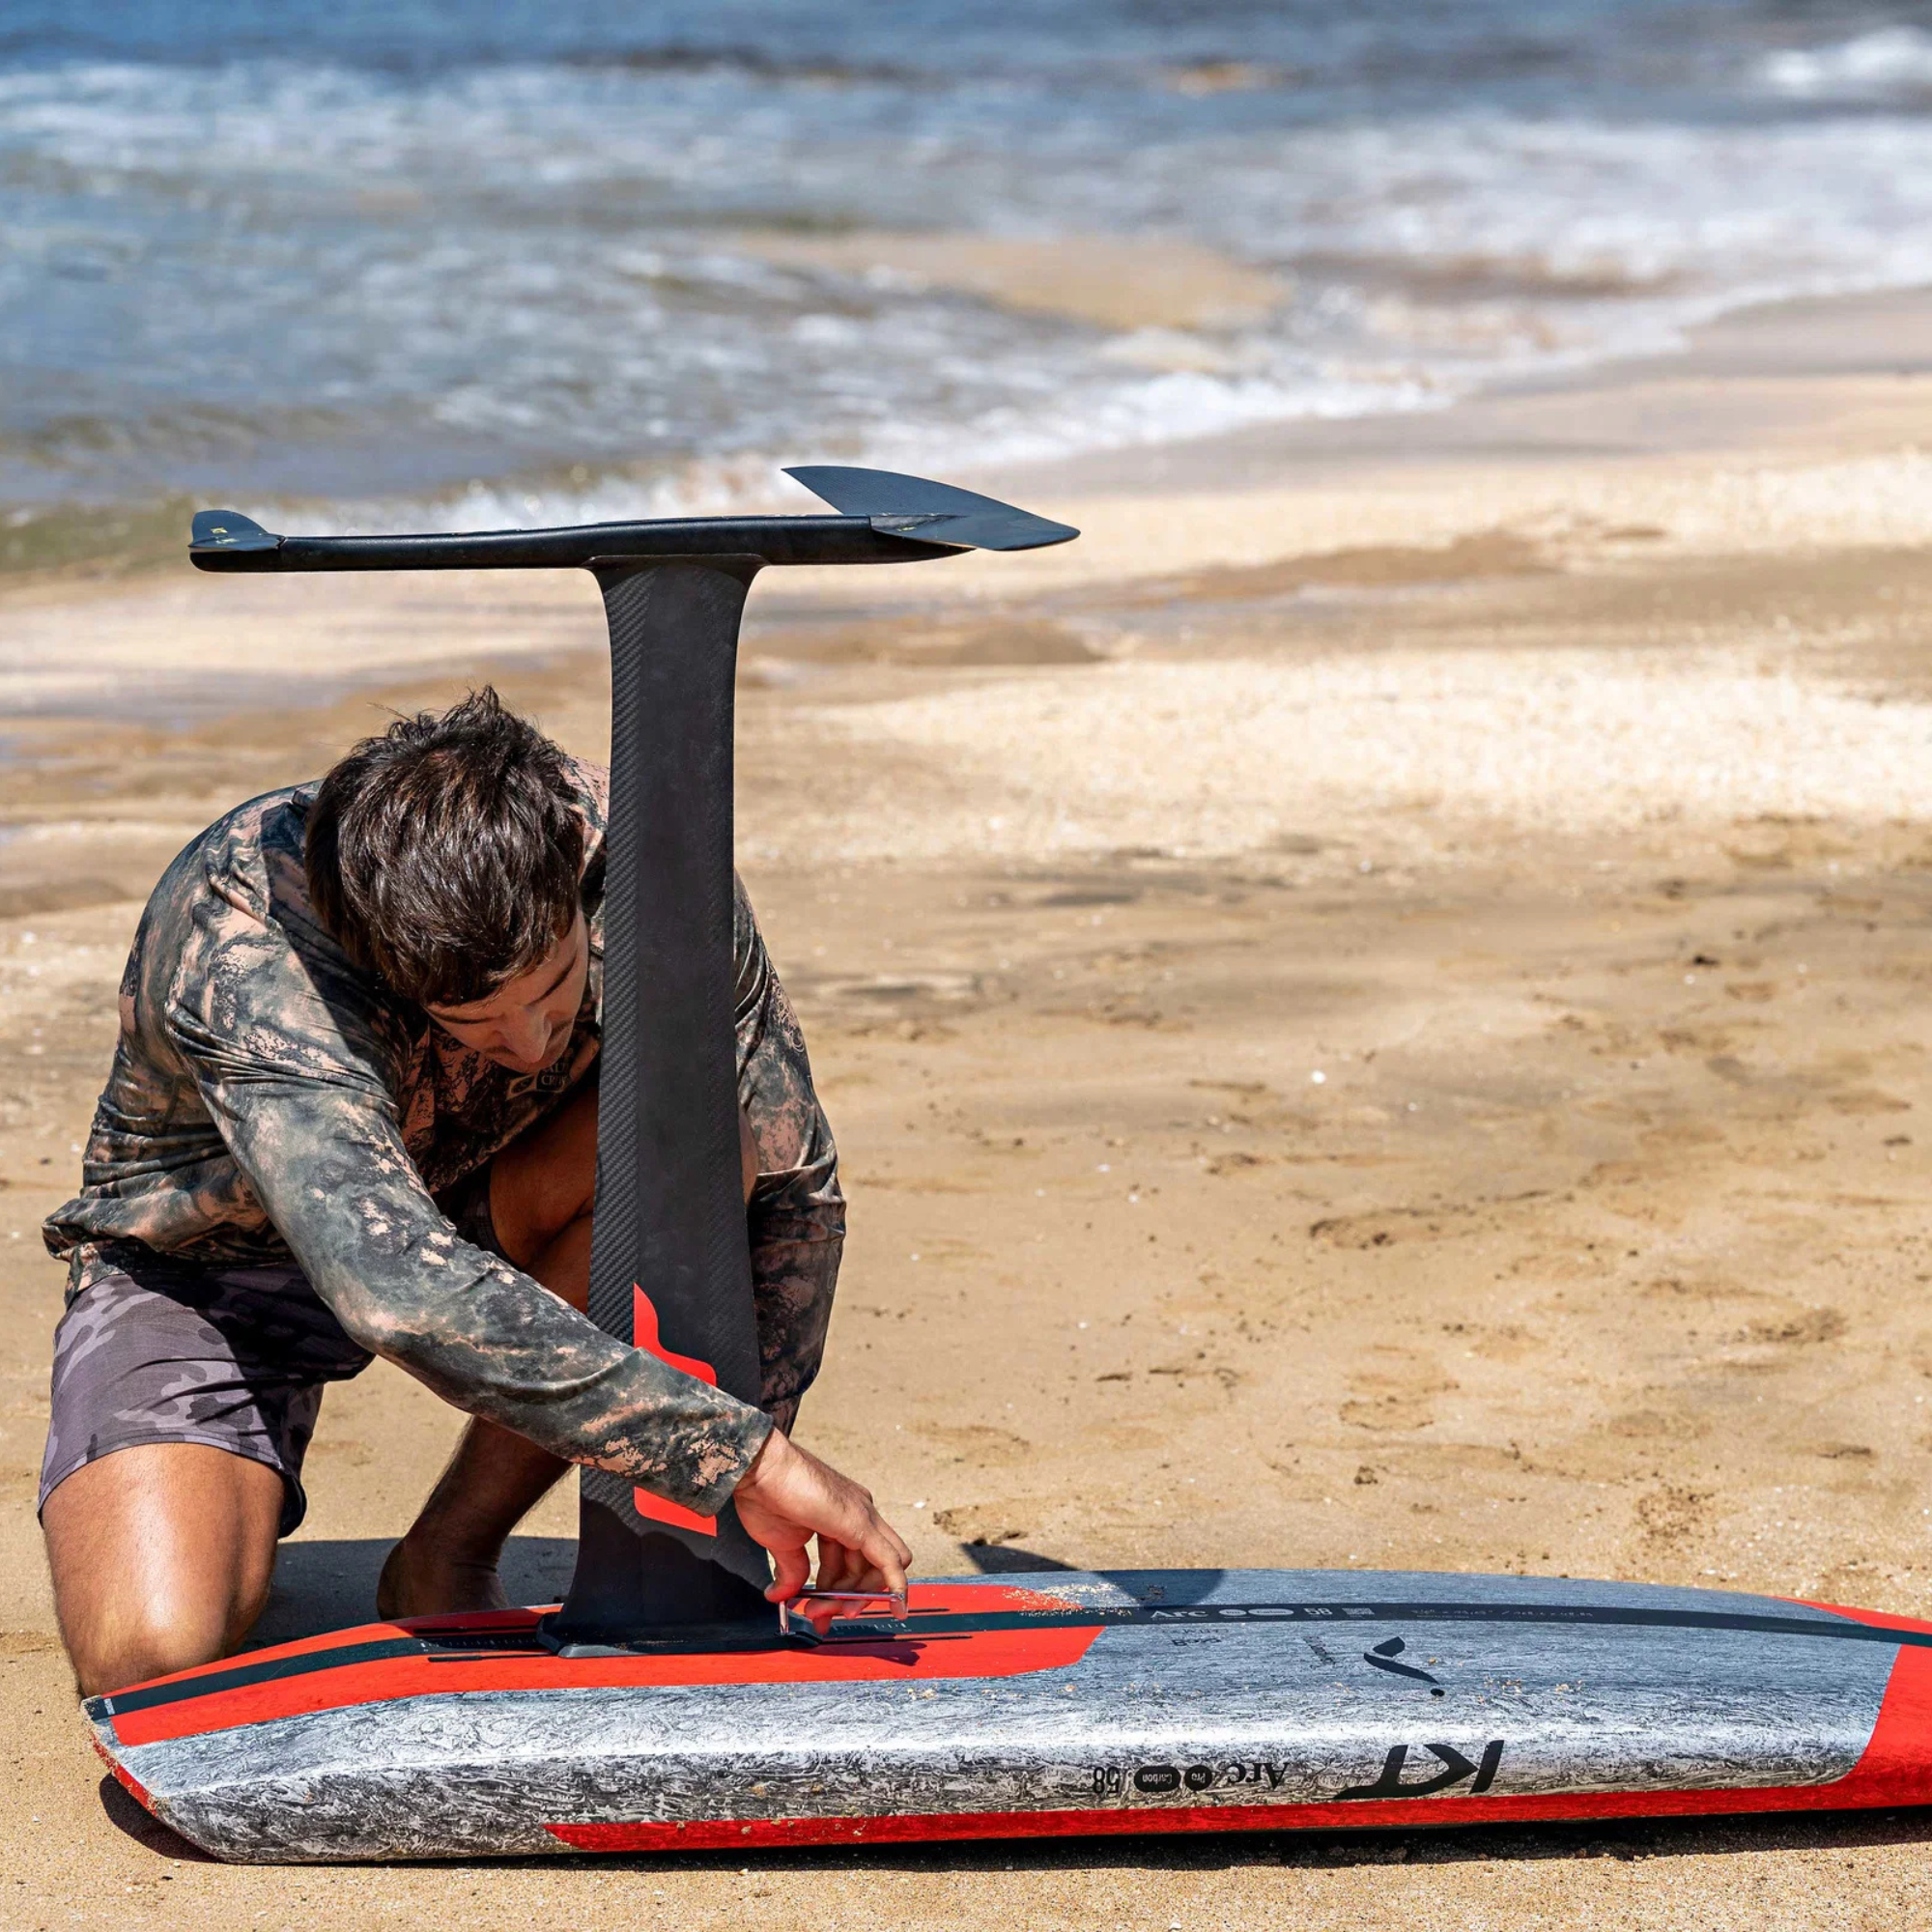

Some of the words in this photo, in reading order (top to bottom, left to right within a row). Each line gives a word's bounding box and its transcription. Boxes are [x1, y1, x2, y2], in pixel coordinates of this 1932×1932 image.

[1150, 1609, 1209, 1618] Arc
[1093, 1766, 1120, 1793] 58
[1142, 1773, 1173, 1785] Carbon
[1190, 1773, 1207, 1783] Pro
[1227, 1762, 1290, 1790] Arc
[1332, 1740, 1504, 1800] KT
